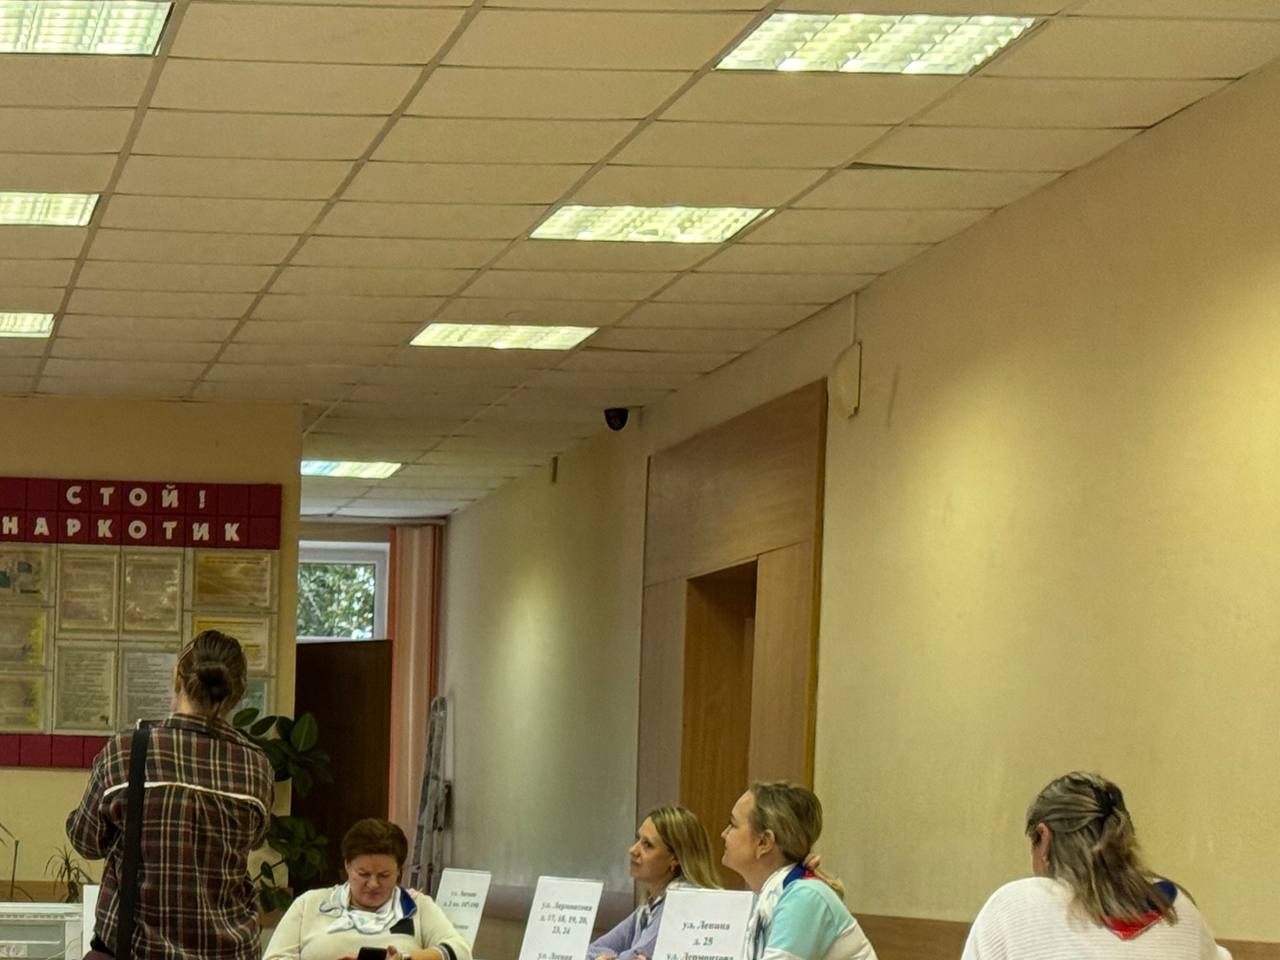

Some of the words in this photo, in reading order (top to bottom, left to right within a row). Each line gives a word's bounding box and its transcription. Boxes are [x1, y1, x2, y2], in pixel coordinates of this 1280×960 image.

[66, 484, 206, 509] СТОЙ!
[2, 516, 240, 541] НАРКОТИК
[682, 921, 695, 931] ул.
[697, 920, 730, 930] Ленина
